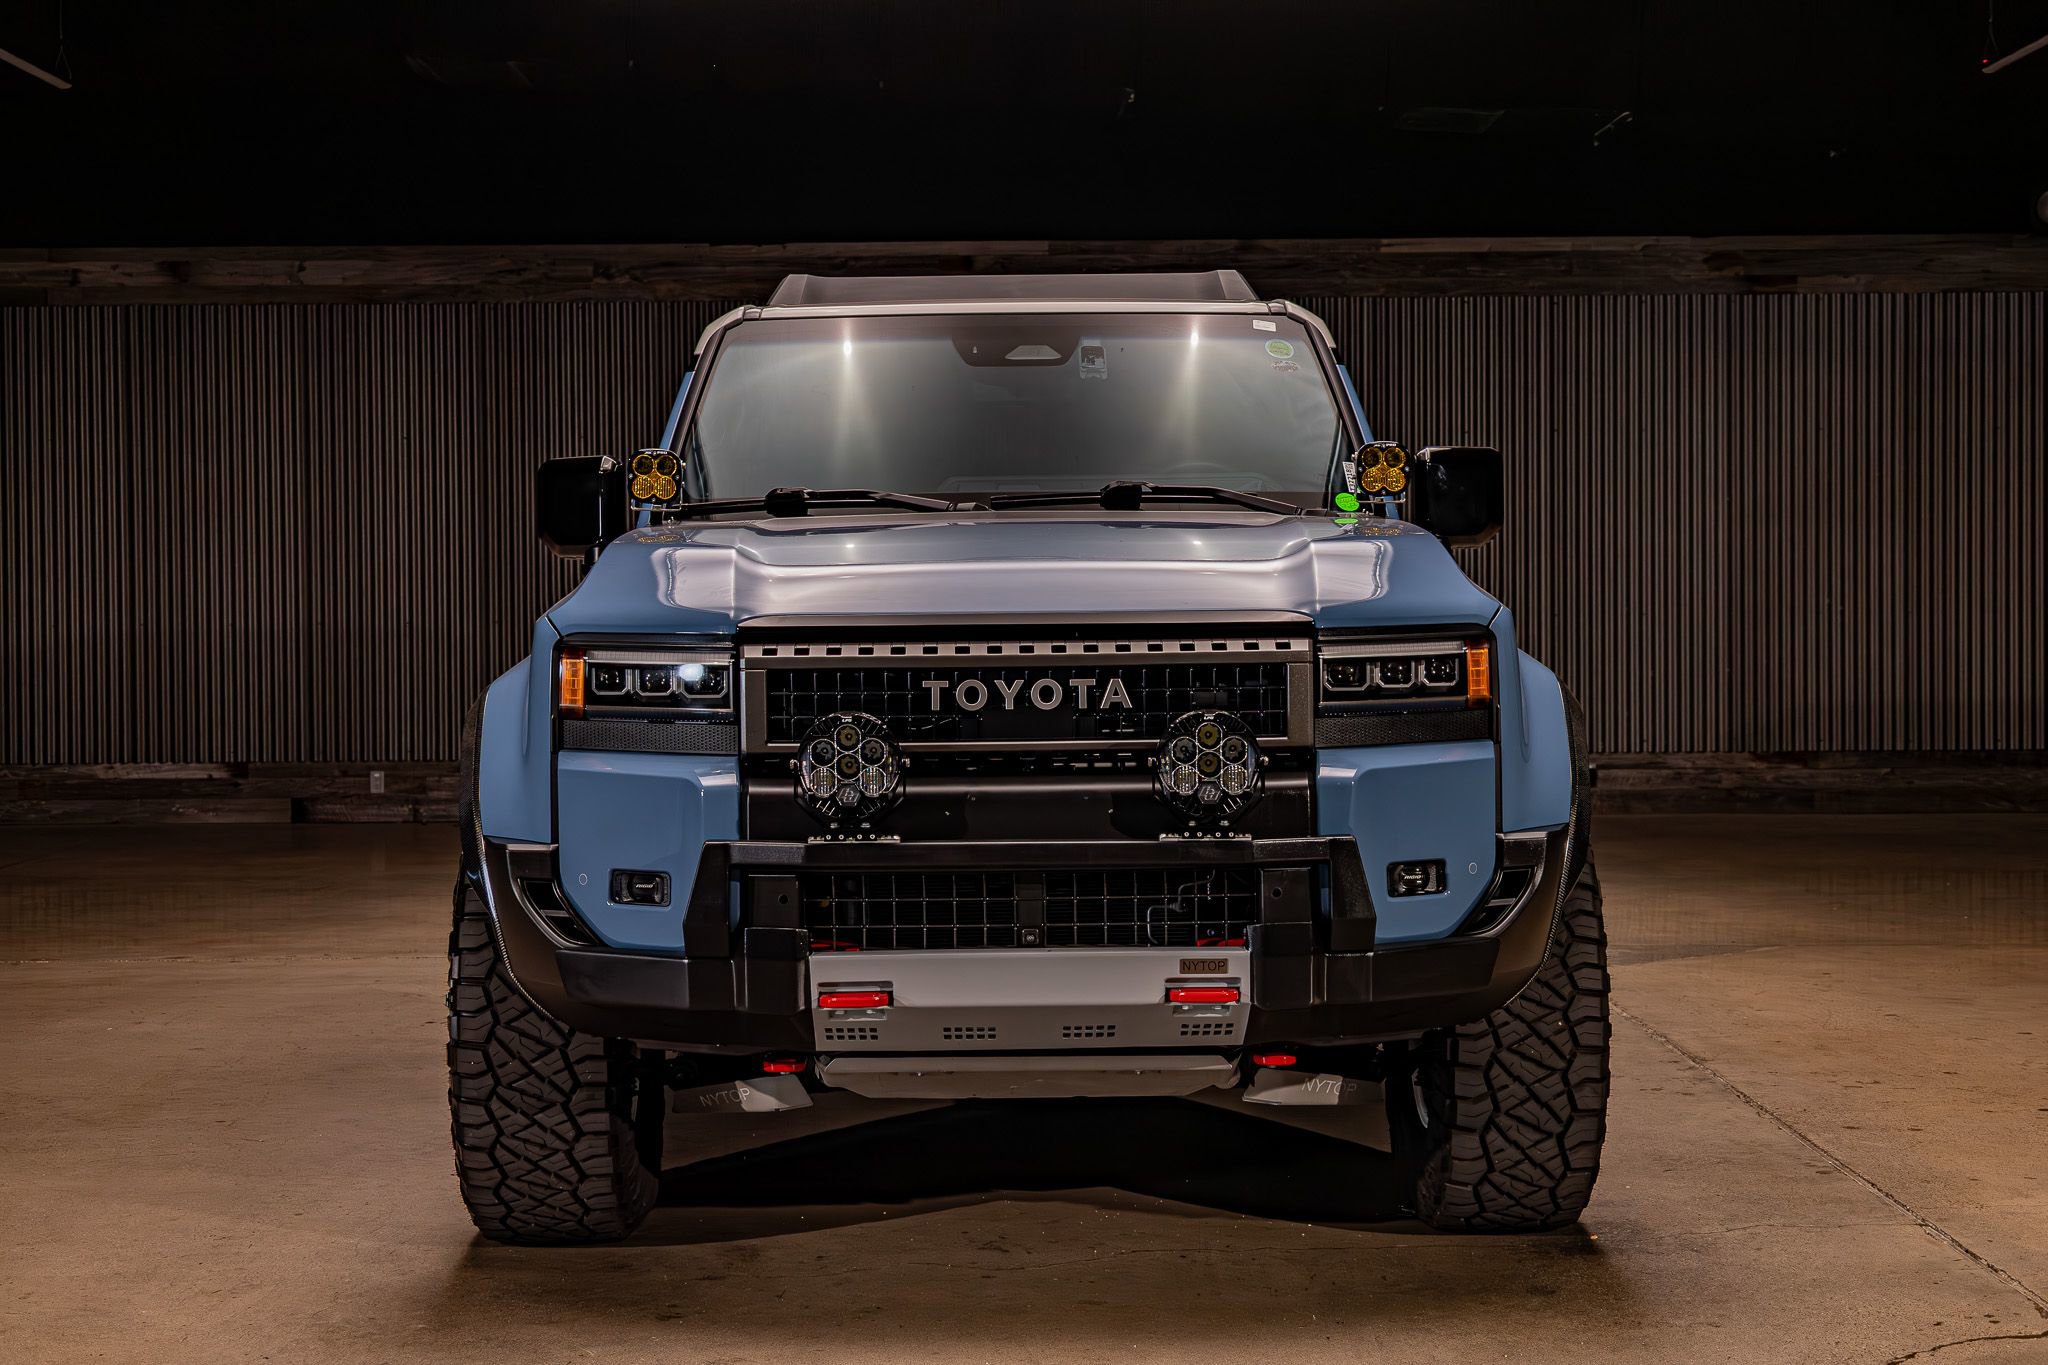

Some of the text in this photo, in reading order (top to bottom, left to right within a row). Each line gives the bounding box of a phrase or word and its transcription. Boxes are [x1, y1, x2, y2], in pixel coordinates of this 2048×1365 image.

[922, 678, 1133, 711] TOYOTA
[1182, 960, 1226, 971] NYTOP
[699, 1087, 751, 1107] NYTOP
